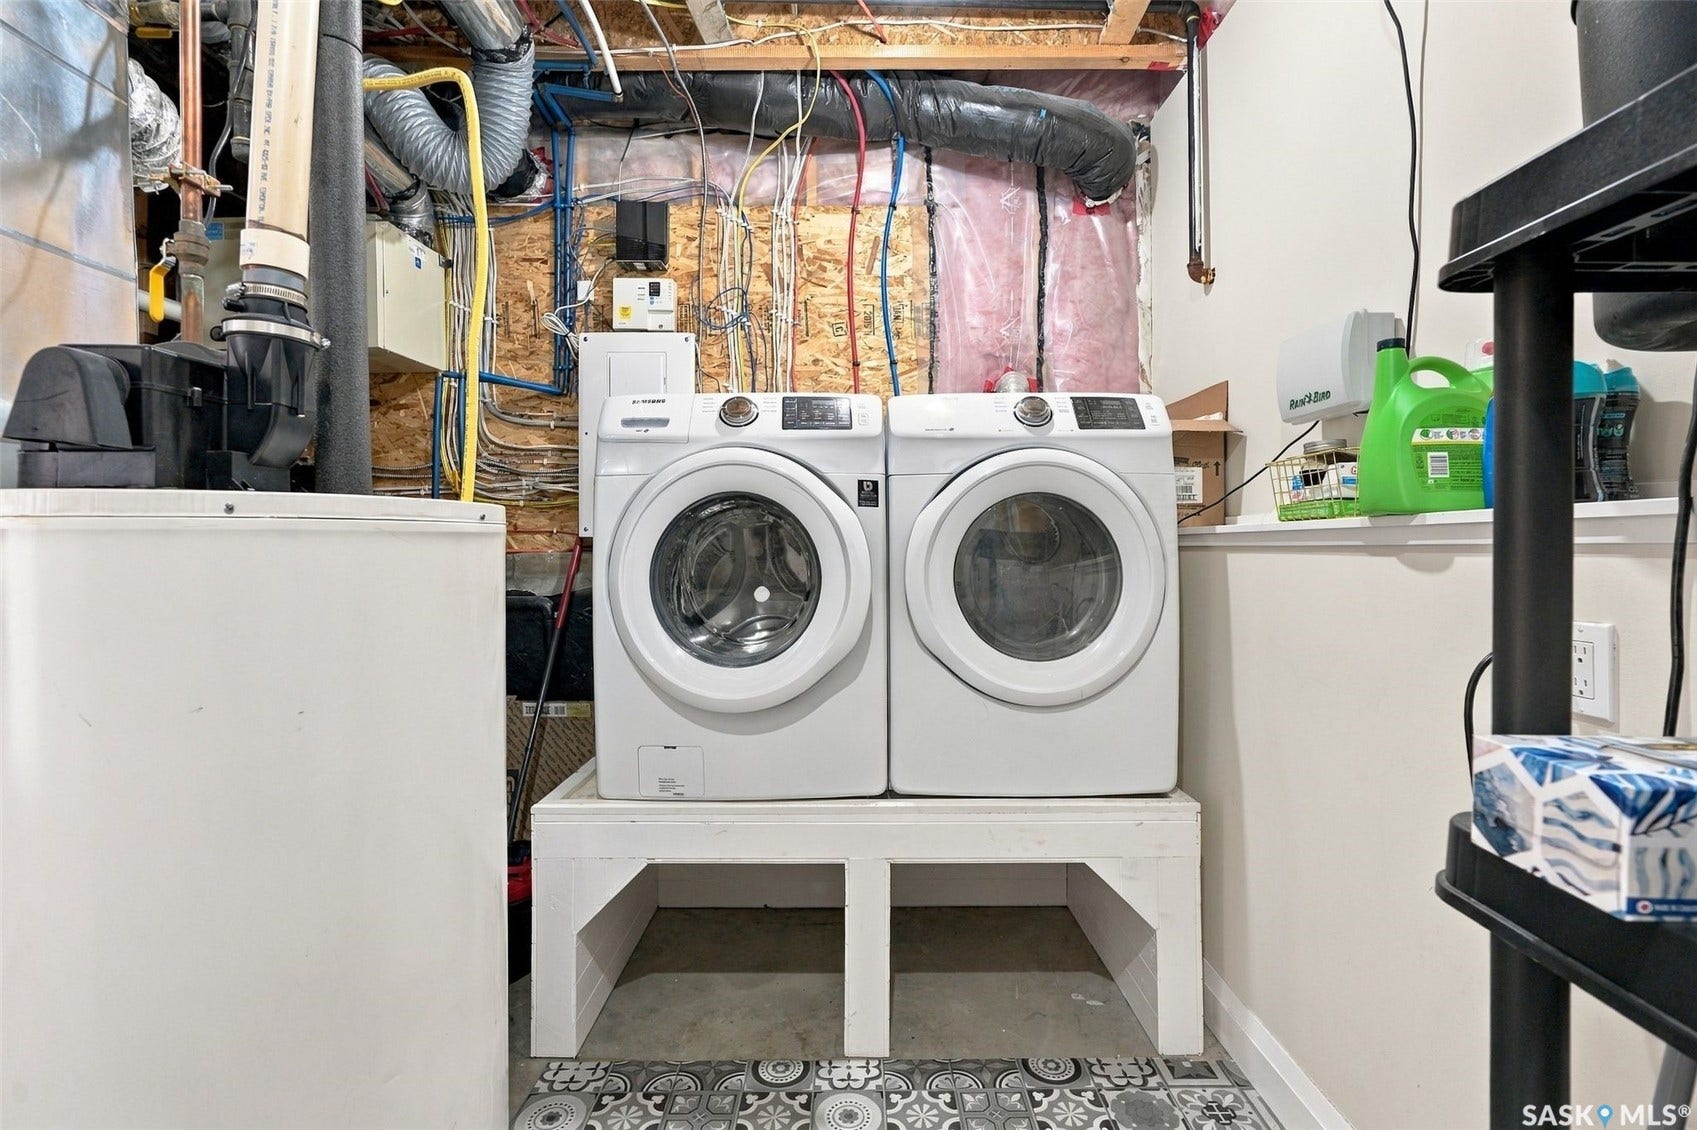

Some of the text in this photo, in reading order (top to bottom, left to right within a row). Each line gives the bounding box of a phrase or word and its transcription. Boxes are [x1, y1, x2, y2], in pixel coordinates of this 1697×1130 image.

[863, 311, 872, 329] 2015
[1289, 391, 1331, 410] RAIN BIRD
